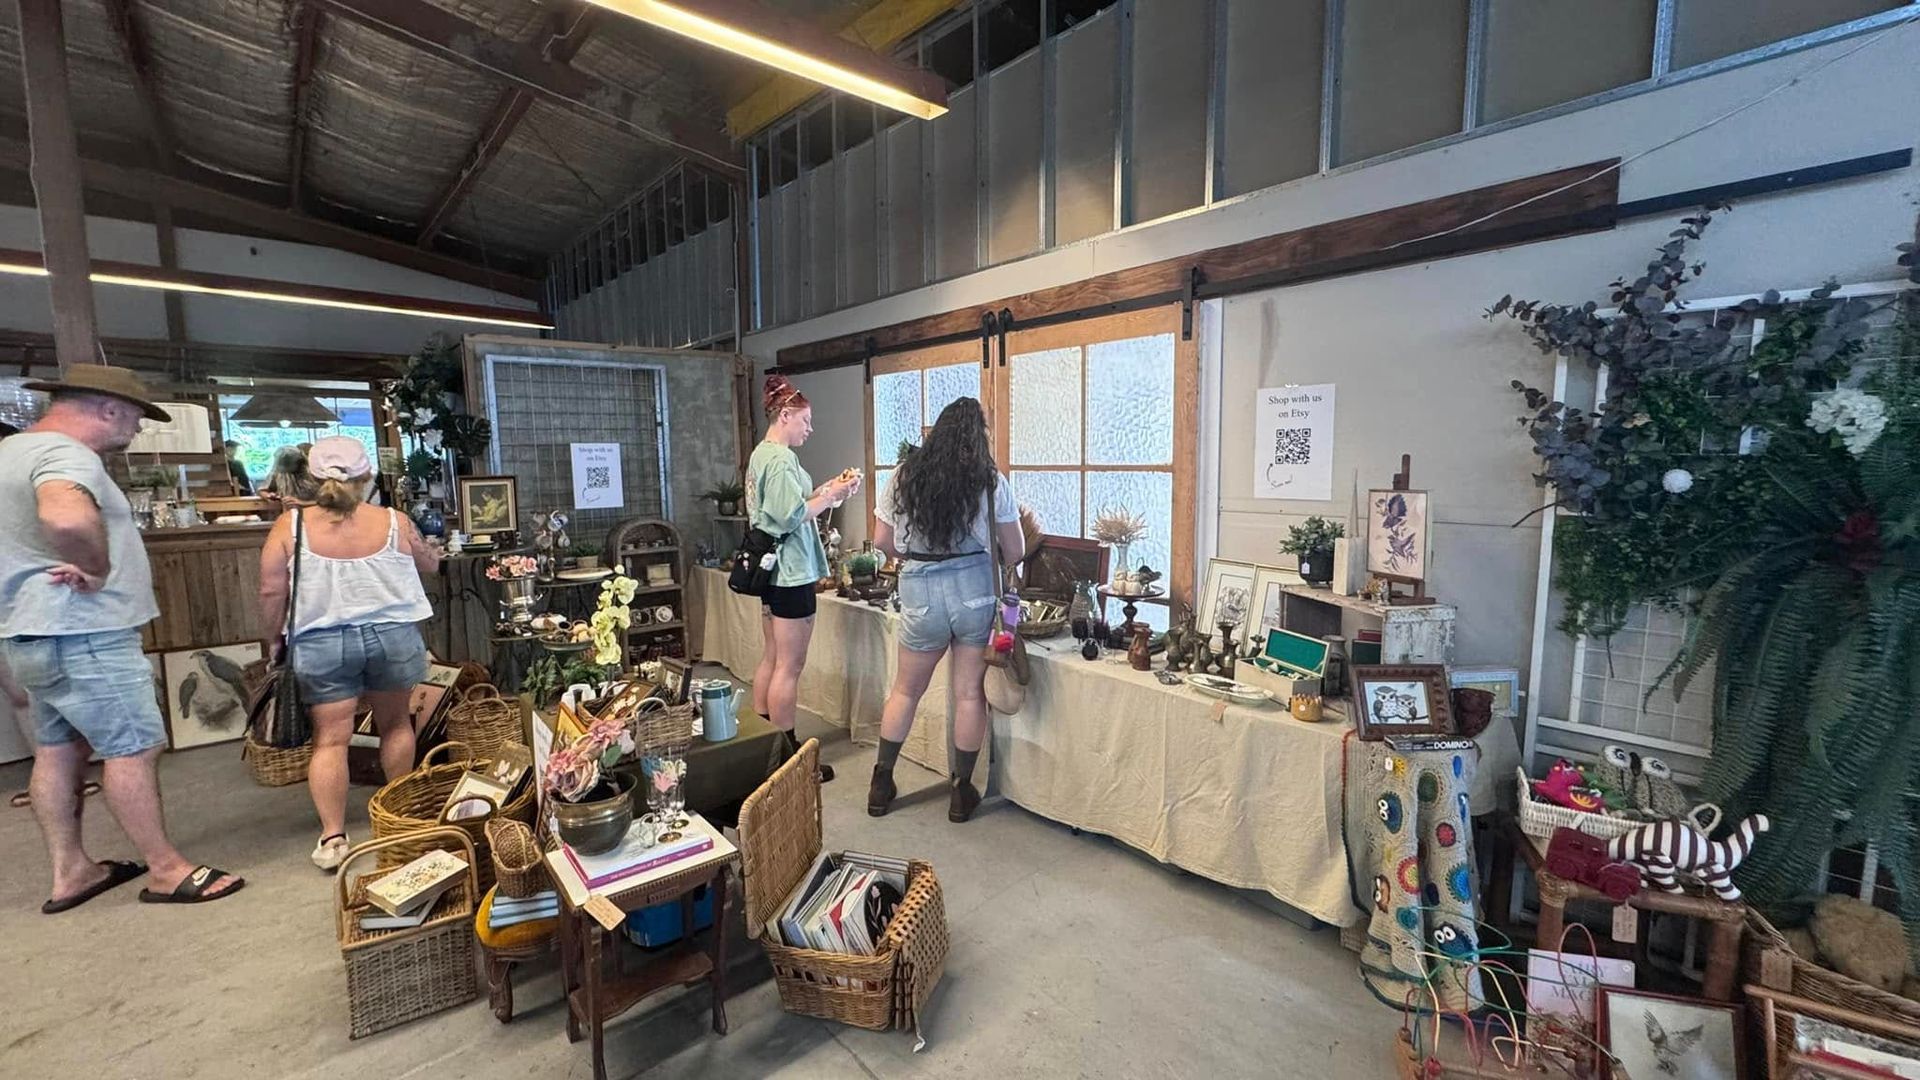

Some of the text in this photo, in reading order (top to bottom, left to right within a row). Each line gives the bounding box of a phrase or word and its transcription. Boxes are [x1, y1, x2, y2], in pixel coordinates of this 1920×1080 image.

[1268, 393, 1323, 406] Shop with us
[1291, 408, 1310, 419] Etsy
